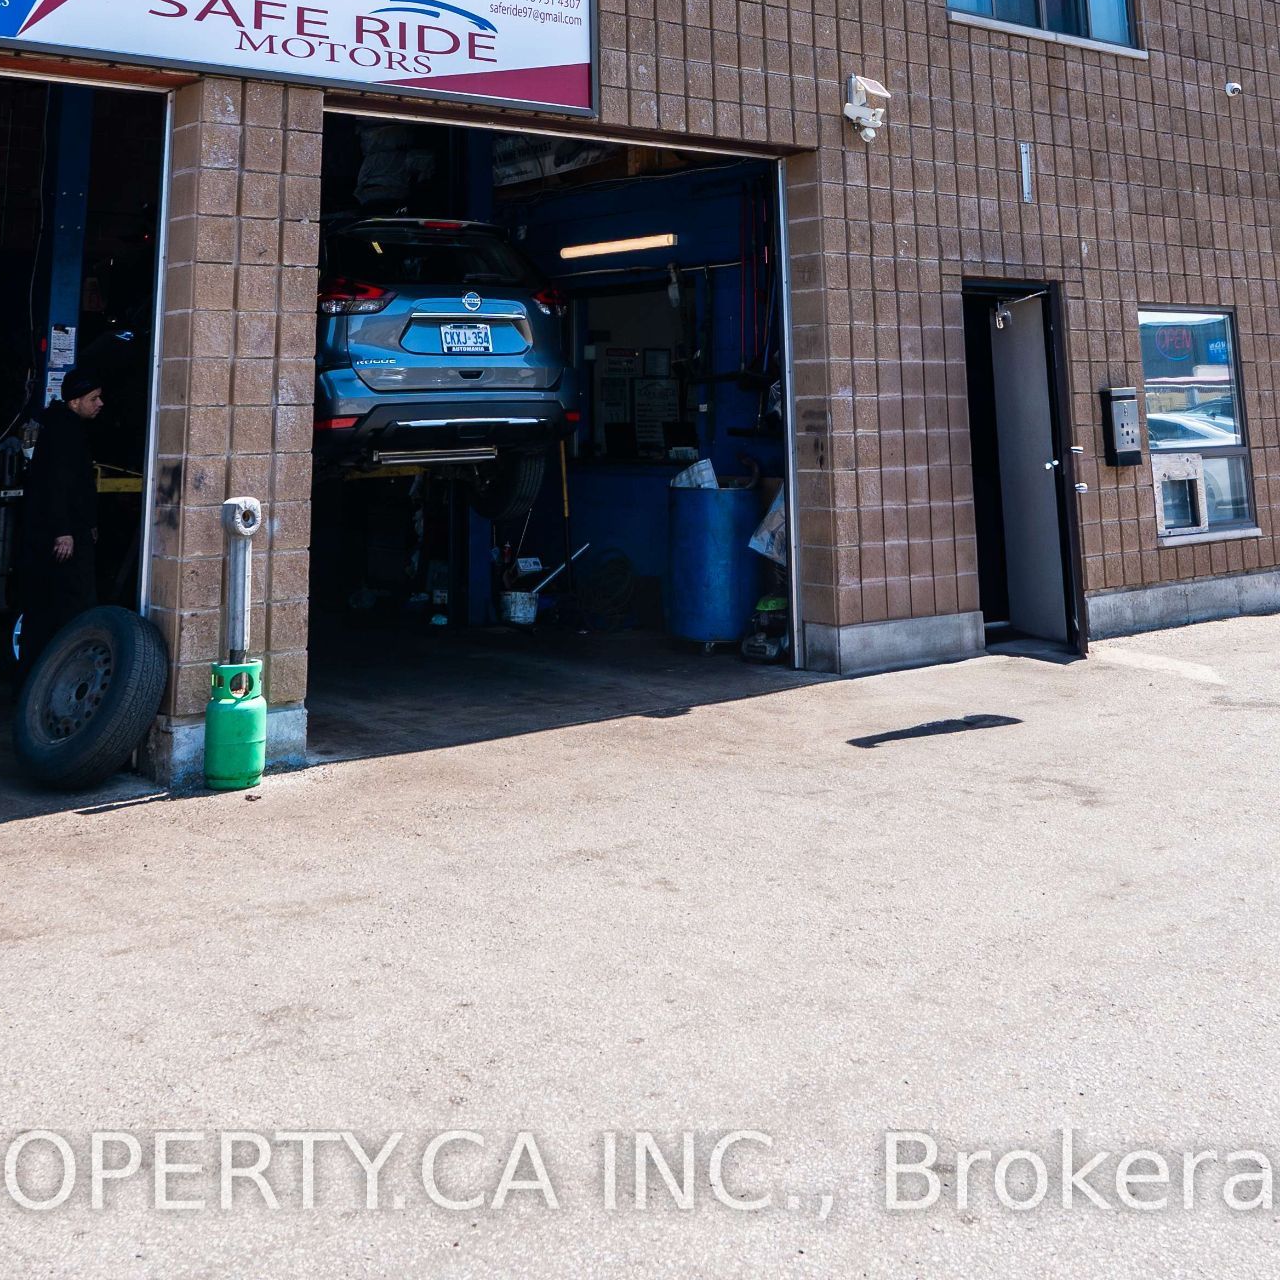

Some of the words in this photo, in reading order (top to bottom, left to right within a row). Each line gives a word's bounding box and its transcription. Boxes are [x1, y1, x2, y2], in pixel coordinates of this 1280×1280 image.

[489, 2, 582, 26] saferide97@gmail.com
[234, 30, 432, 75] MOTORS
[355, 15, 498, 63] RIDE
[1158, 327, 1192, 350] OPEN
